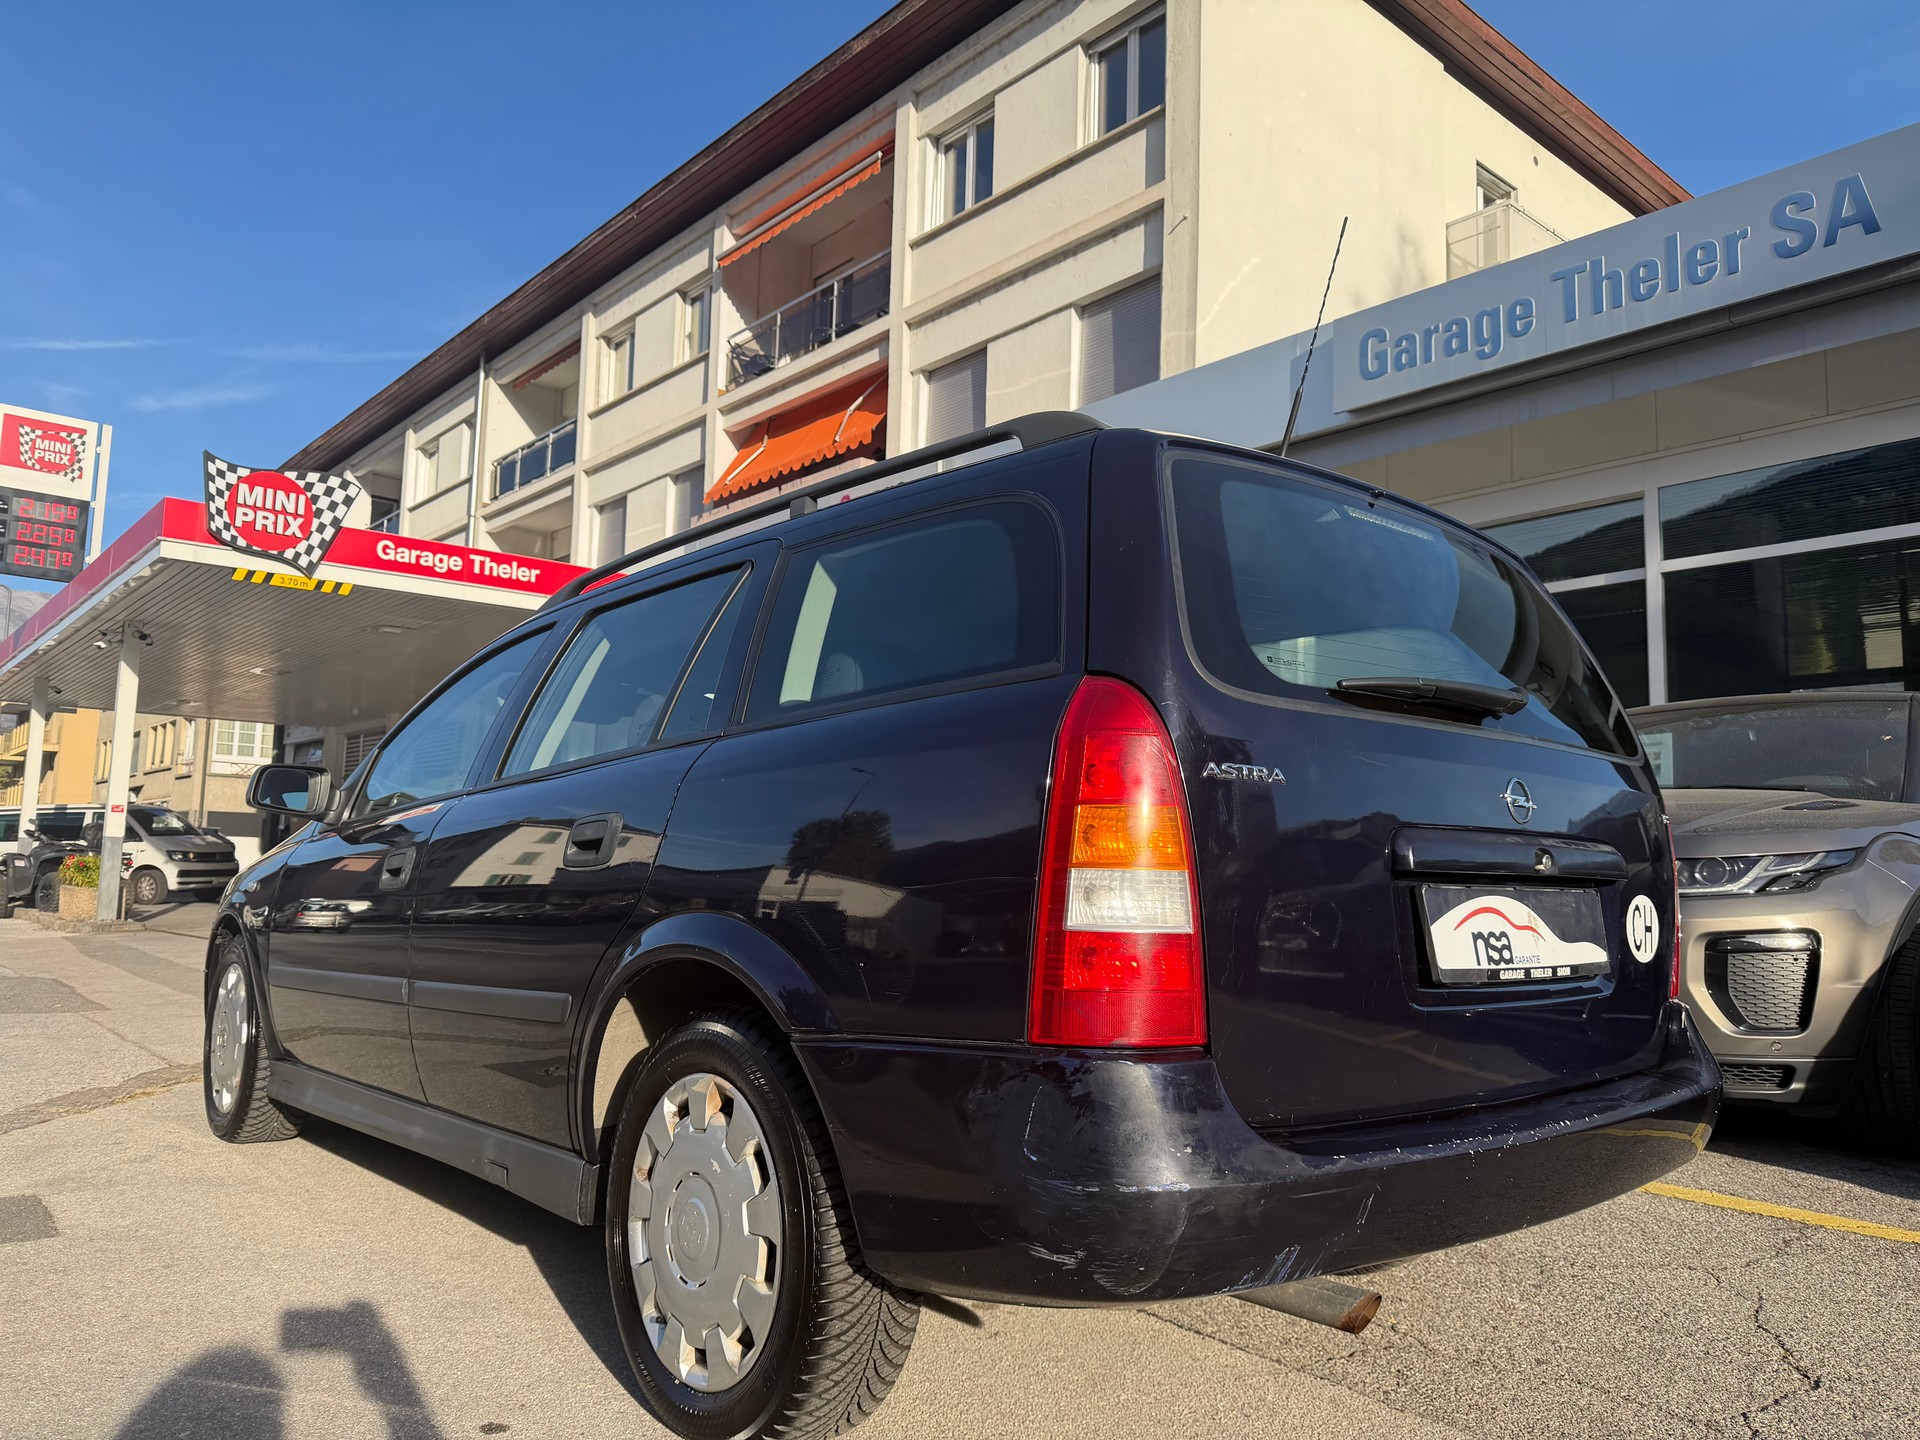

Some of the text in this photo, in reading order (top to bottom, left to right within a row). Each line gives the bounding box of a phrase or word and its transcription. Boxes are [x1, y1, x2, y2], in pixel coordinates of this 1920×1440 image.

[1358, 172, 1882, 381] Garage Theler SA
[34, 451, 71, 466] PRIX
[35, 438, 72, 454] MINI
[237, 482, 307, 516] MINI
[234, 506, 305, 538] PRIX
[376, 539, 541, 583] Garage Theler
[1200, 761, 1287, 785] ASTRA
[1632, 904, 1653, 954] CH
[1471, 930, 1541, 967] nsa GARANTIE
[1500, 966, 1571, 980] GARAGE THELER SION
